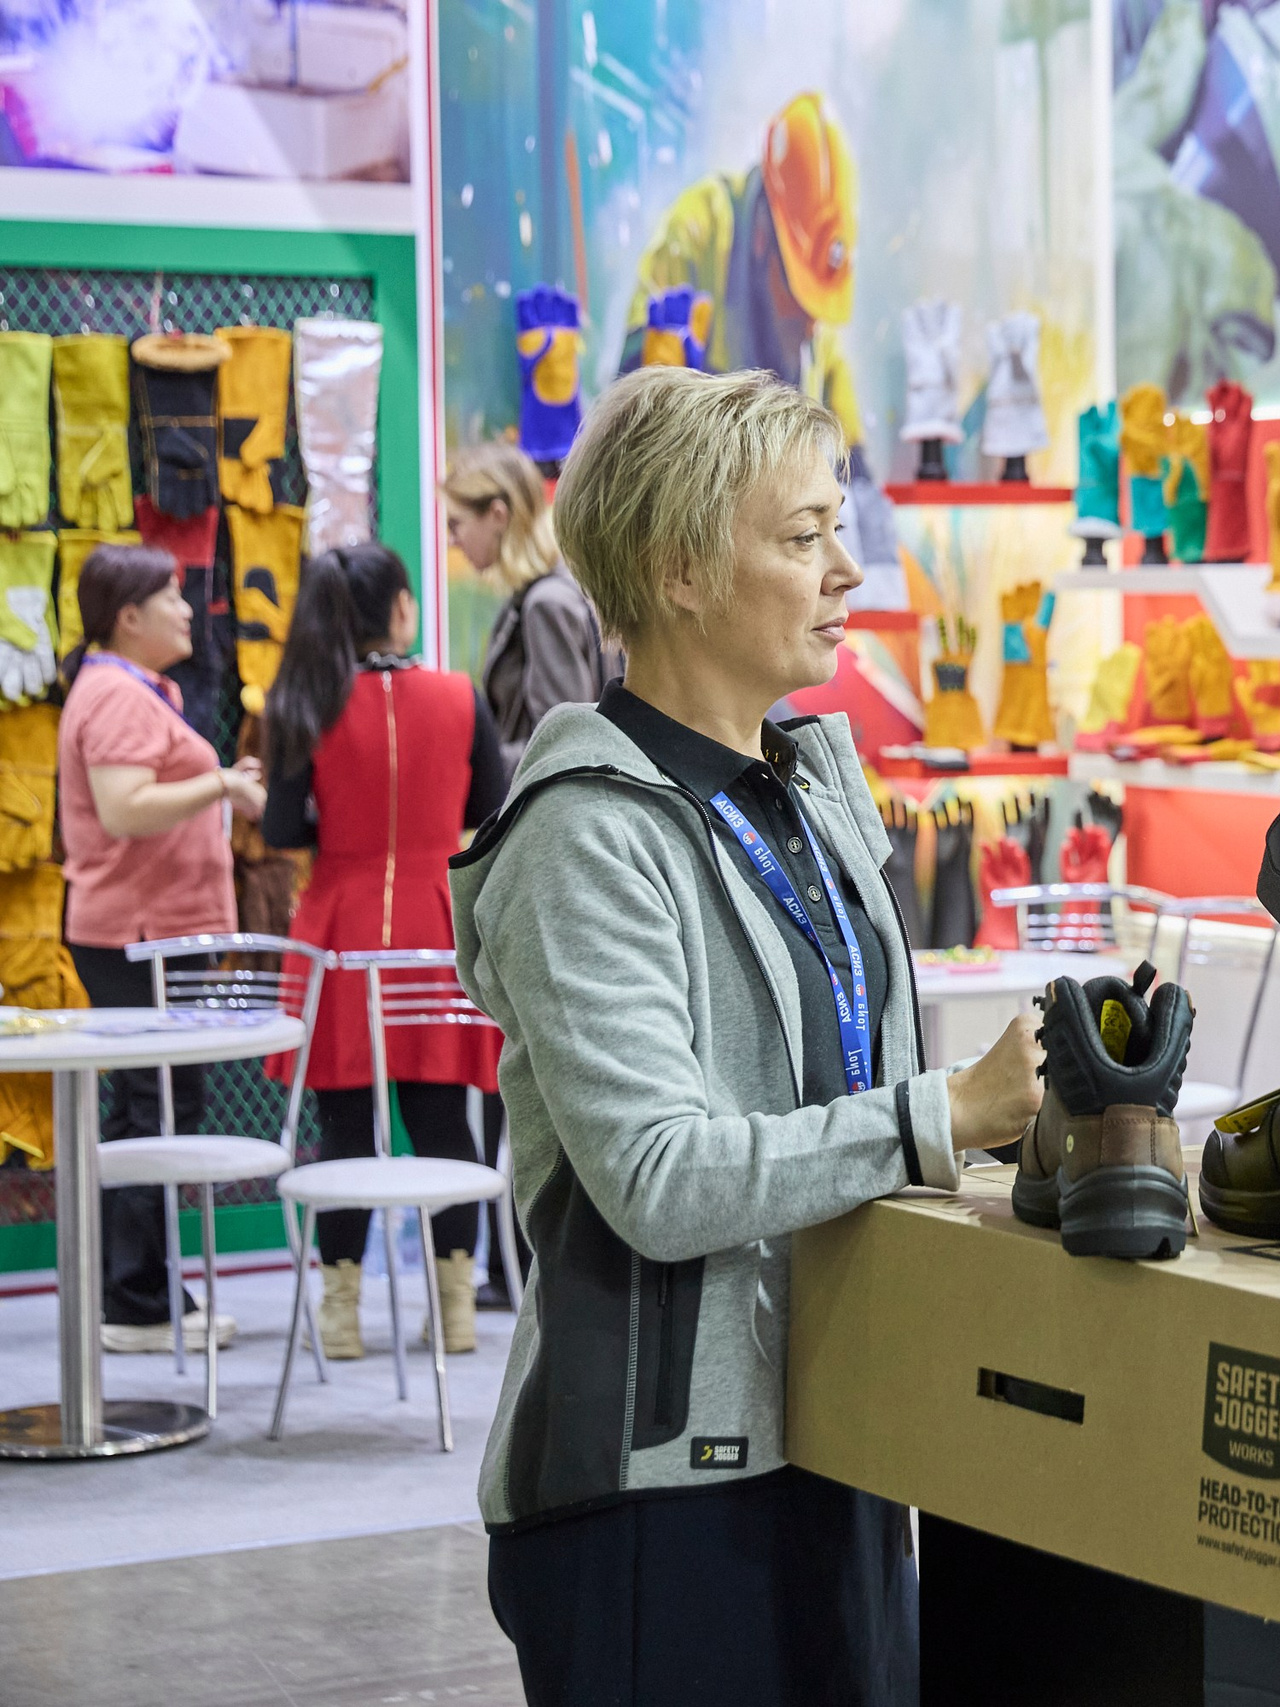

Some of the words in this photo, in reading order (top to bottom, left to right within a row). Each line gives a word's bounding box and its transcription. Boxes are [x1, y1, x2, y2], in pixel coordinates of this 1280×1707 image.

[716, 799, 744, 828] АСИЗ
[849, 944, 863, 977] АСИЗ
[836, 991, 852, 1024] АСИЗ
[714, 1445, 740, 1453] SAFETY
[1229, 1440, 1275, 1468] WORKS
